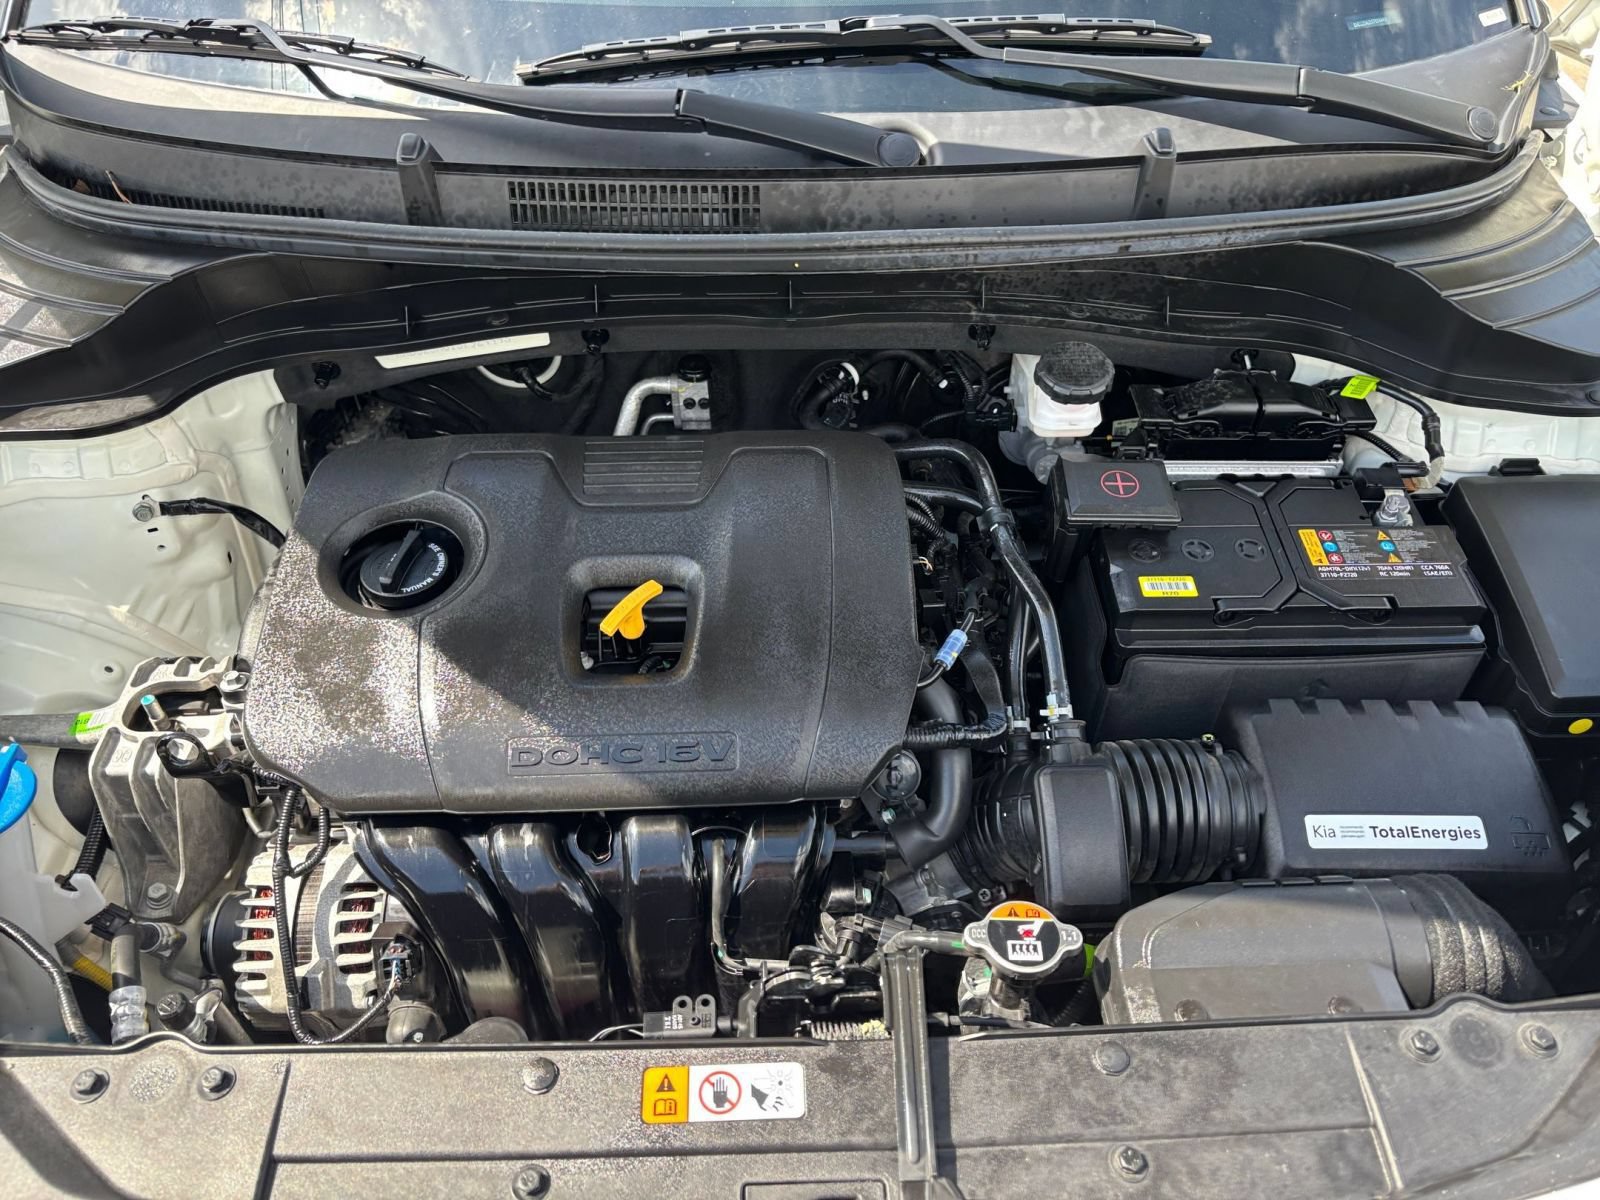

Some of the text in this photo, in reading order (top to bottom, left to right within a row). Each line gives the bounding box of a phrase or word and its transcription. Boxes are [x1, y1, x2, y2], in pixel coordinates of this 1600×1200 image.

[427, 543, 442, 553] SEE
[401, 577, 434, 593] MANUAL
[511, 740, 735, 768] DOHC 16V
[1312, 825, 1337, 838] Kia
[1369, 826, 1481, 841] TotalEnergies
